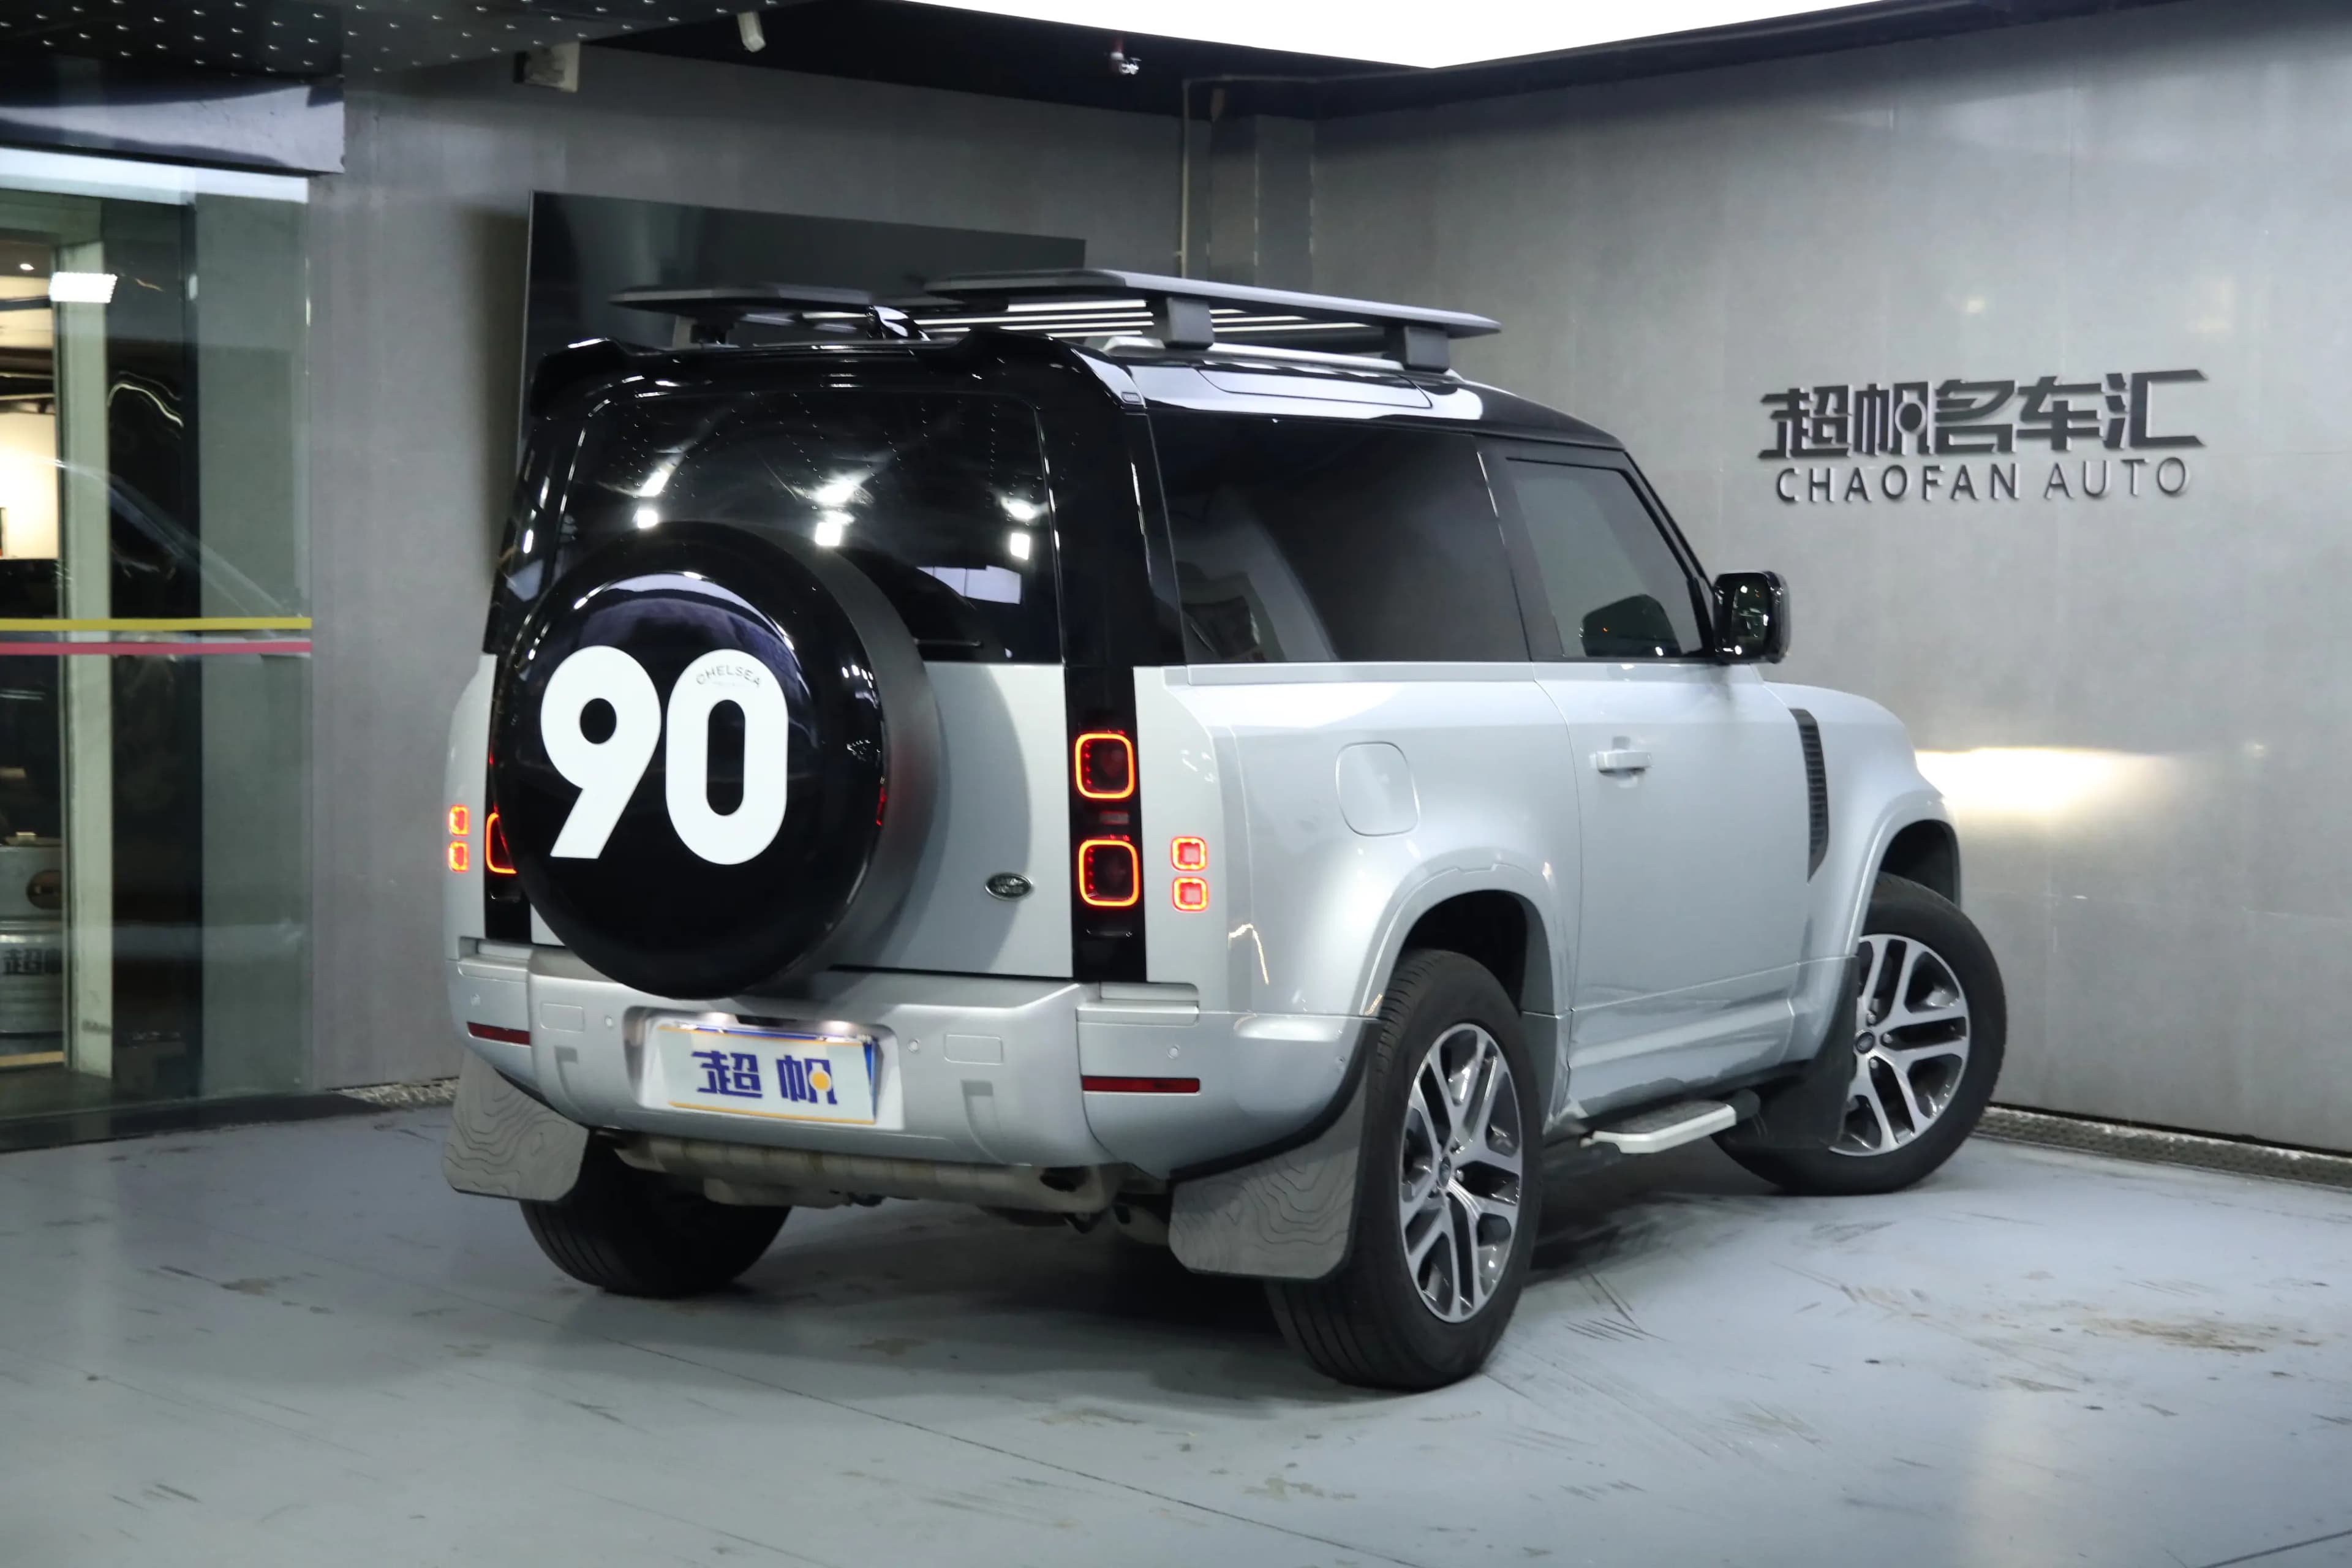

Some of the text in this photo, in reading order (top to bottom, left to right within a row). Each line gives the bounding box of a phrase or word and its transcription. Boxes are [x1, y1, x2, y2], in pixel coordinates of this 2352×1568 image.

[1758, 369, 2207, 459] 超帆名车汇
[1776, 456, 2191, 502] CHAOFAN AUTO
[696, 665, 761, 687] CHELSEA
[540, 645, 788, 865] 90
